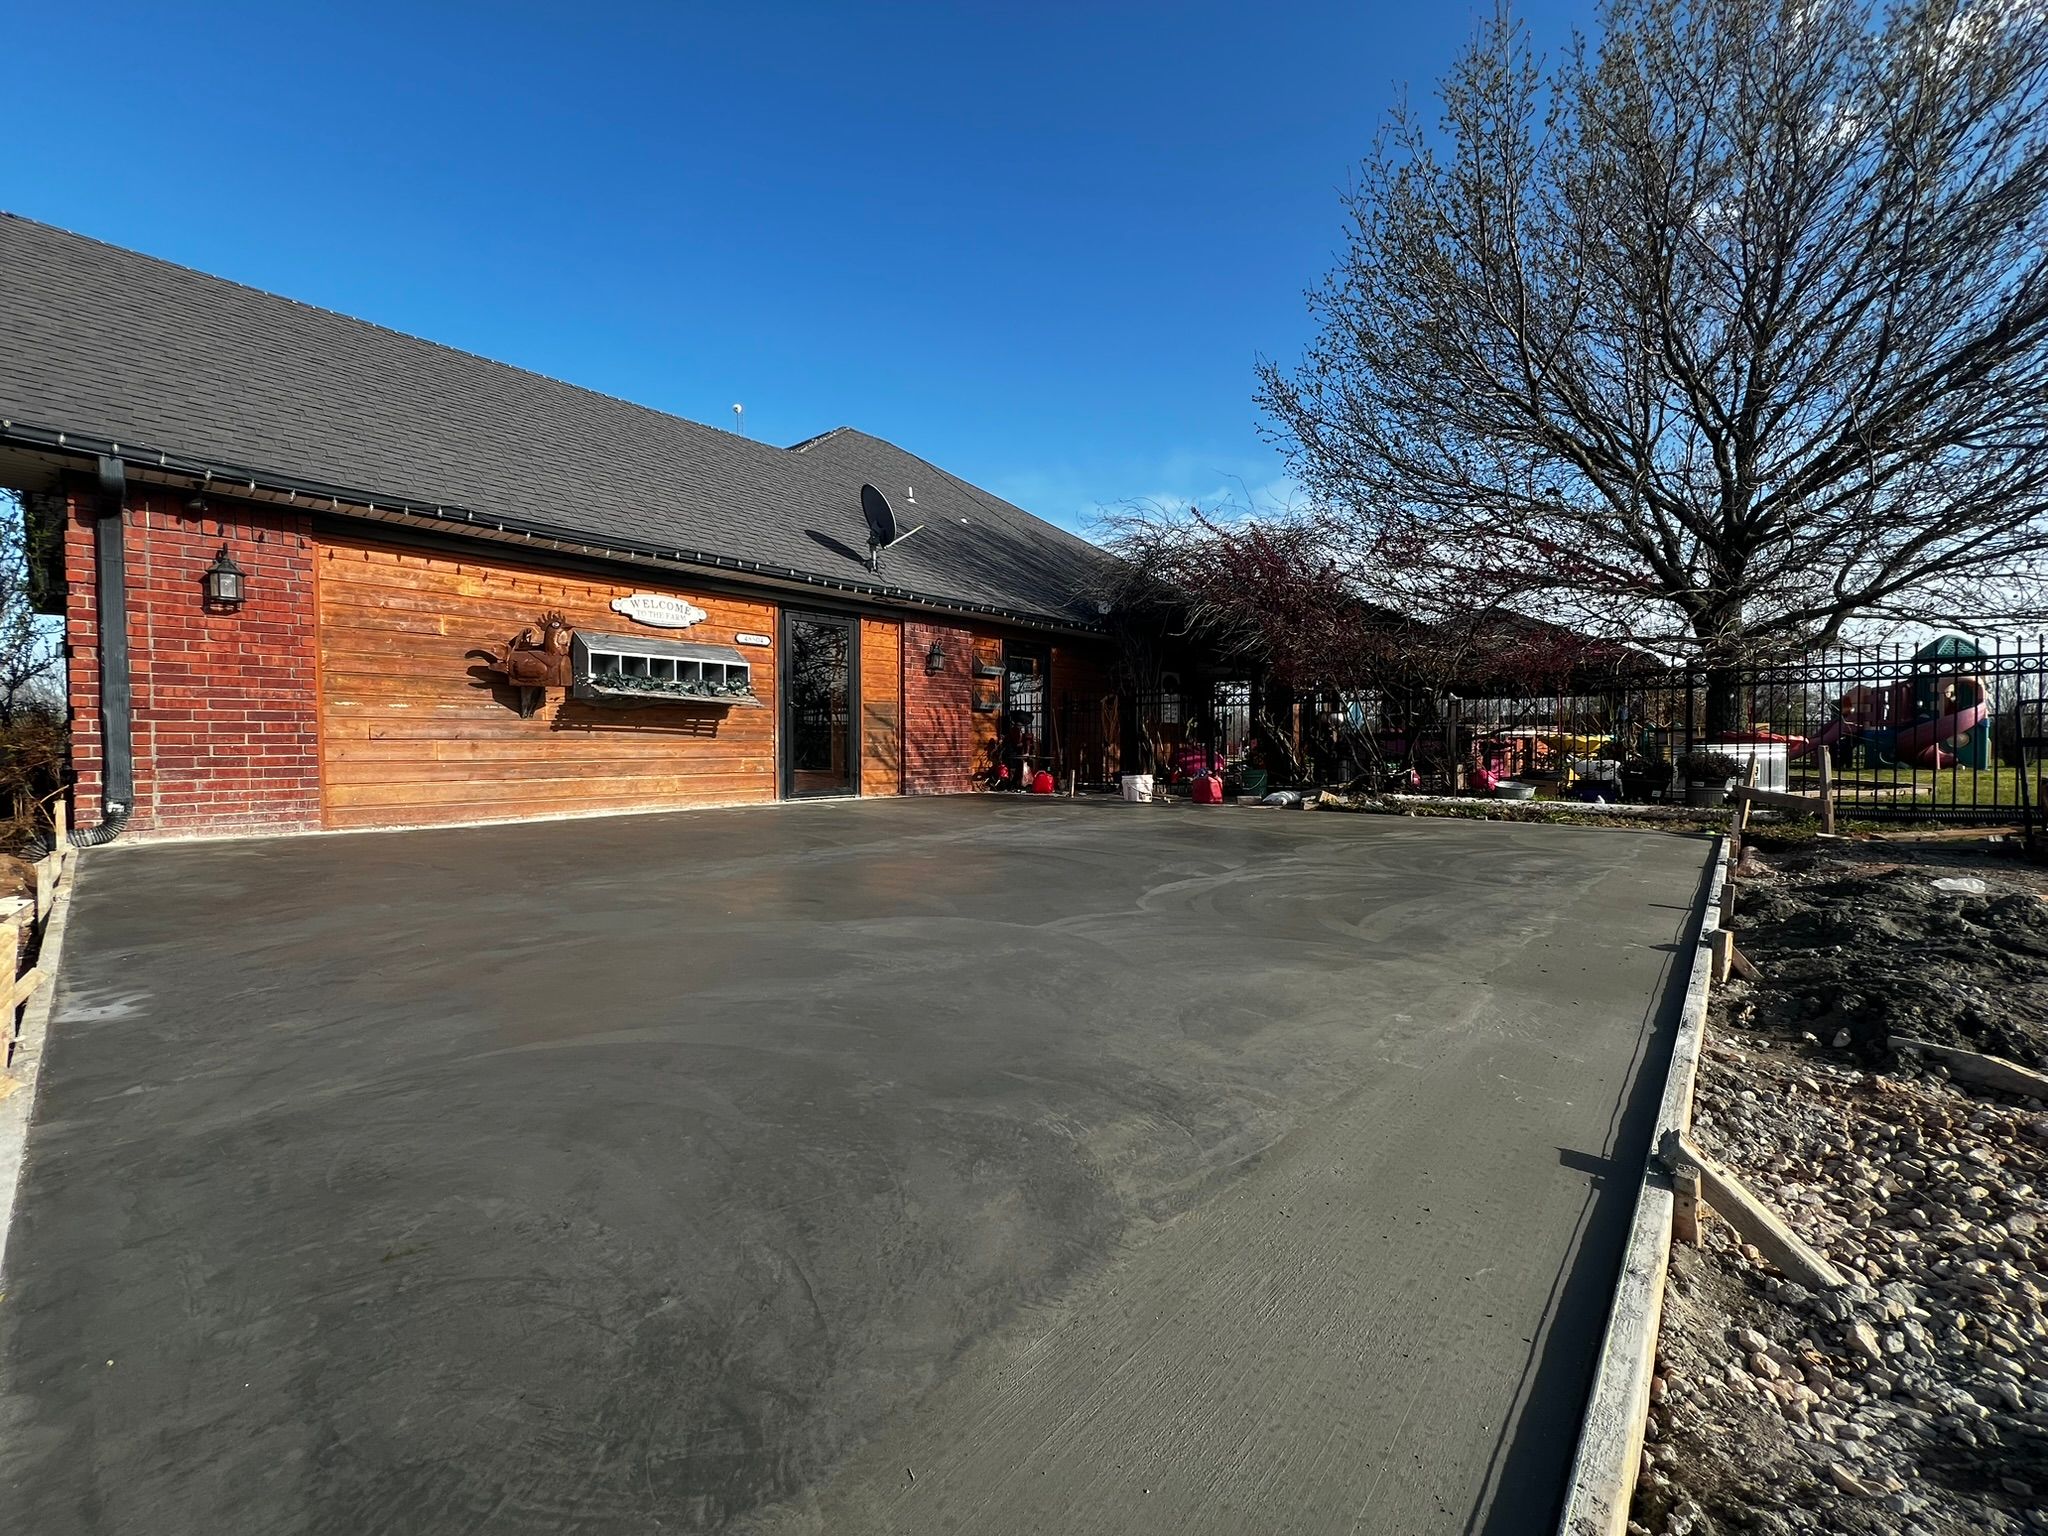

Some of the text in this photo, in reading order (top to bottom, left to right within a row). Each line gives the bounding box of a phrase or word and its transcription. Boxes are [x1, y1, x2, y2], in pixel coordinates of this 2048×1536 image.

[630, 599, 691, 615] WELCOME
[648, 611, 664, 619] THE
[665, 613, 687, 621] FARM
